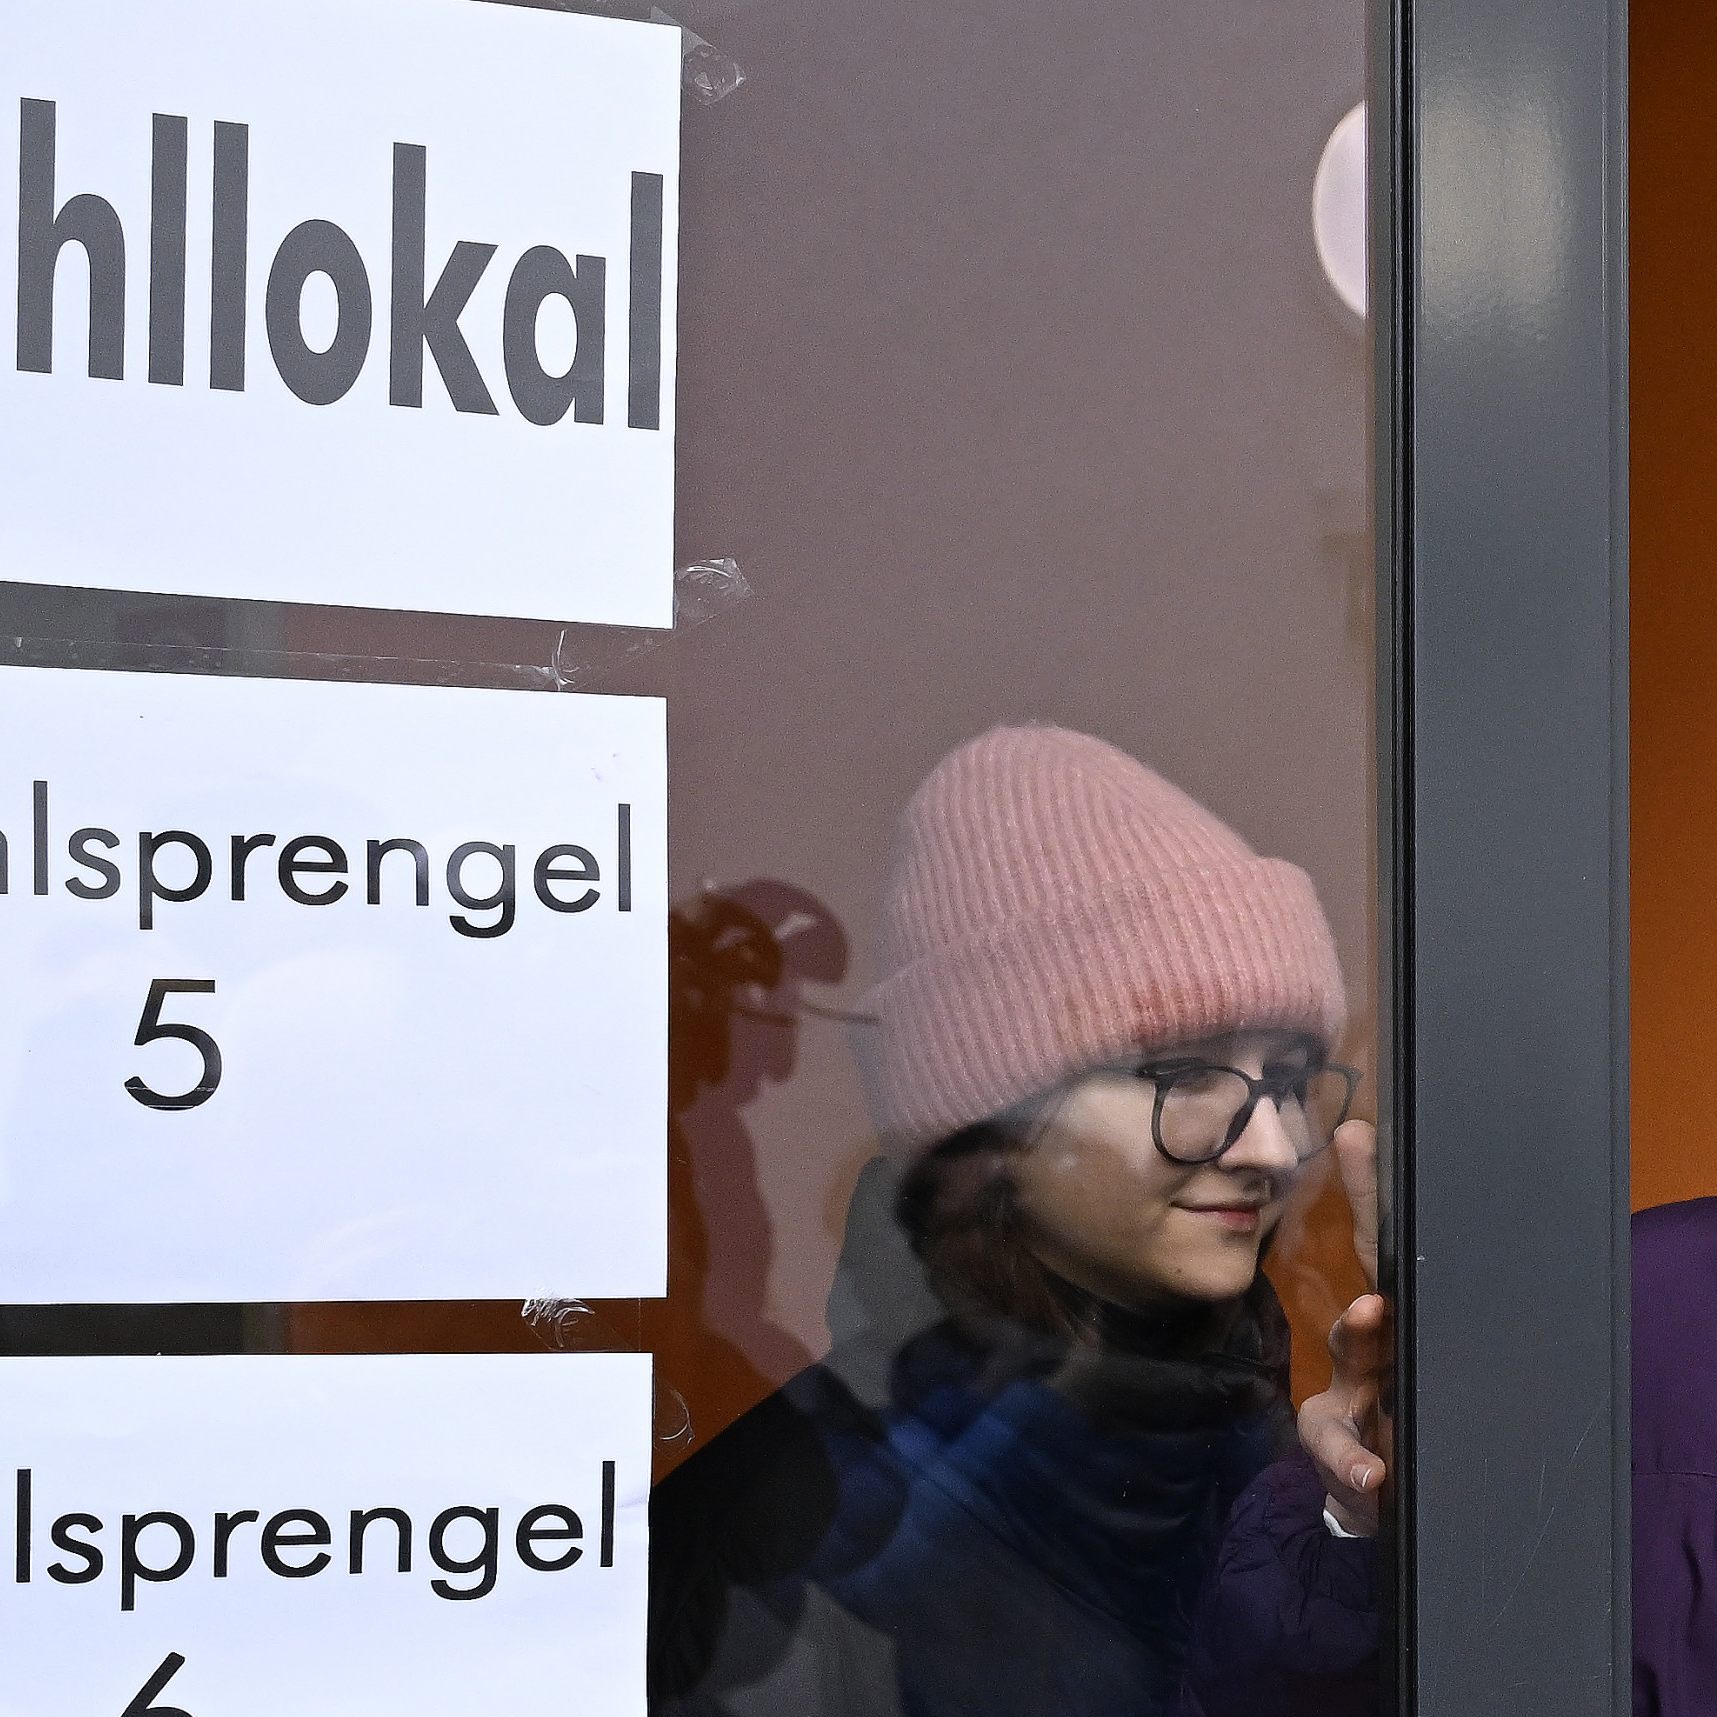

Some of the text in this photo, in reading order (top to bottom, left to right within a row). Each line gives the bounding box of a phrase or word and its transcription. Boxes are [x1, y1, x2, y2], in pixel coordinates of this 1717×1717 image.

[17, 97, 663, 430] hllokal
[0, 780, 631, 938] lsprengel
[124, 979, 222, 1111] 5
[16, 1461, 615, 1611] lsprengel
